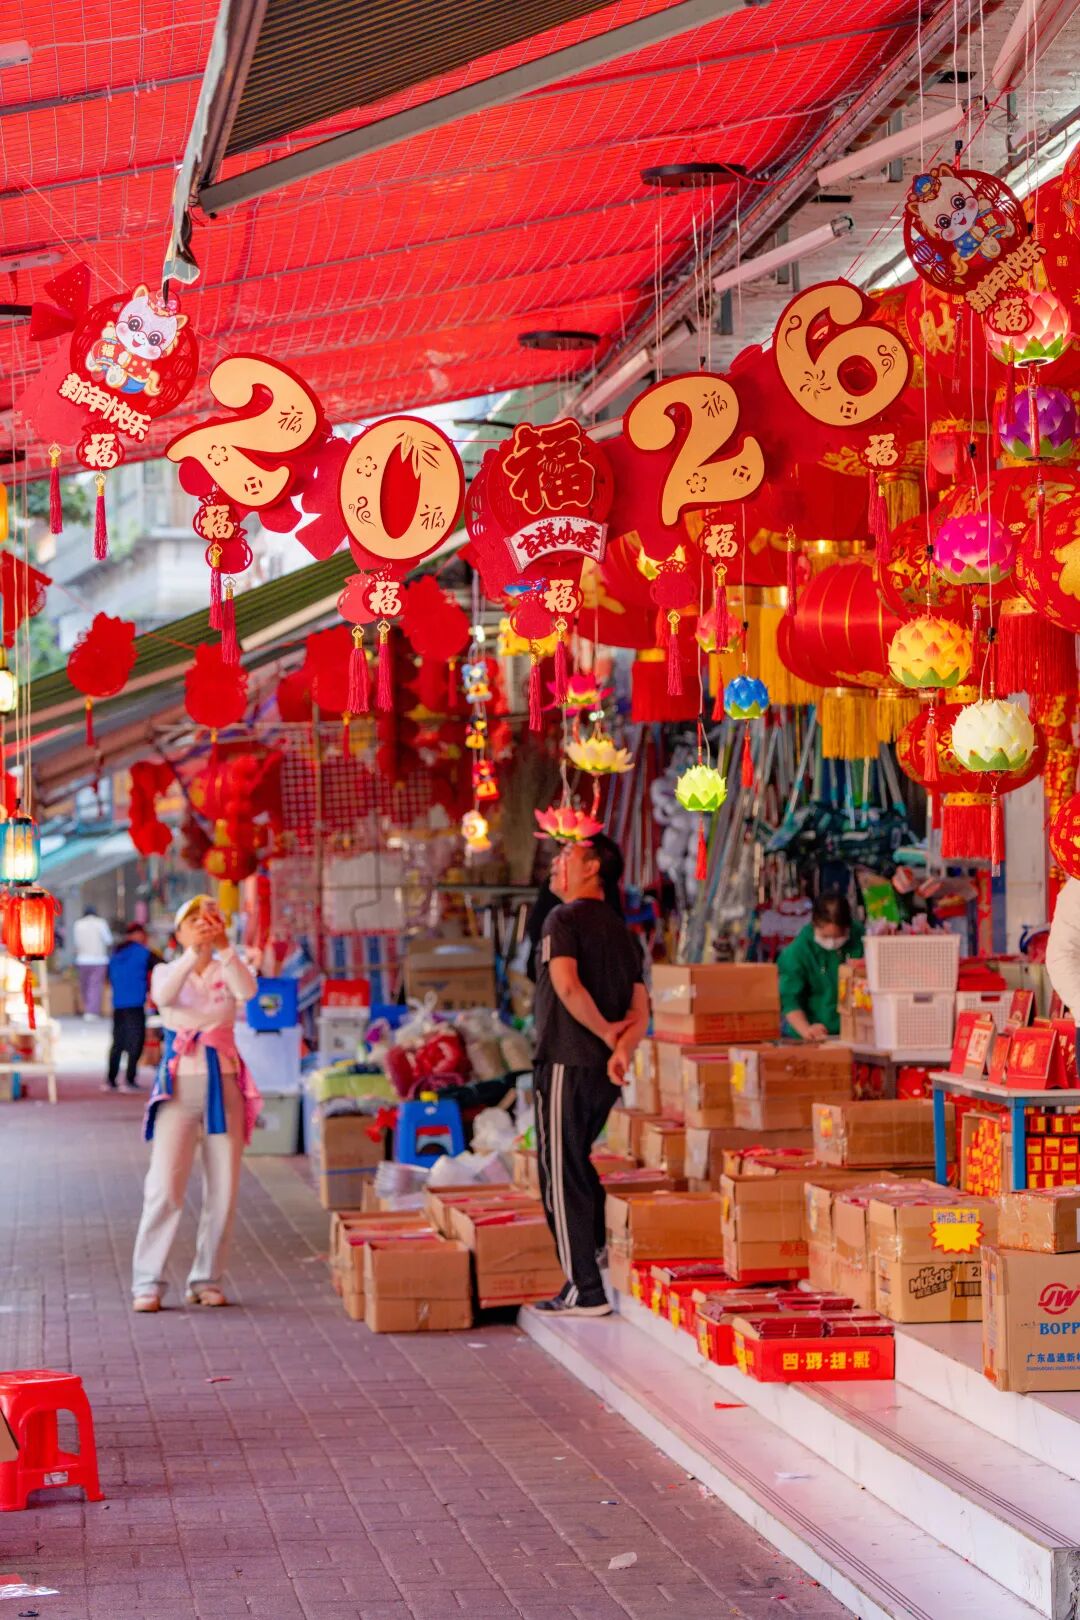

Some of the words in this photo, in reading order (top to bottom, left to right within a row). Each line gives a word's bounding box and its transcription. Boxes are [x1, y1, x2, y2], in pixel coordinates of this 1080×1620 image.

[966, 236, 1046, 313] 新年快乐
[994, 298, 1028, 331] 福
[59, 373, 151, 440] 新年快乐
[84, 433, 118, 468] 福
[865, 433, 898, 466] 福
[502, 420, 595, 515] 福
[200, 505, 234, 539] 福
[517, 521, 600, 559] 吉祥如意
[705, 524, 738, 558] 福
[369, 581, 401, 615] 福
[544, 579, 577, 613] 福
[936, 1212, 977, 1223] 新品上市
[910, 1269, 952, 1292] Muscle
[1040, 1322, 1080, 1335] BOPP
